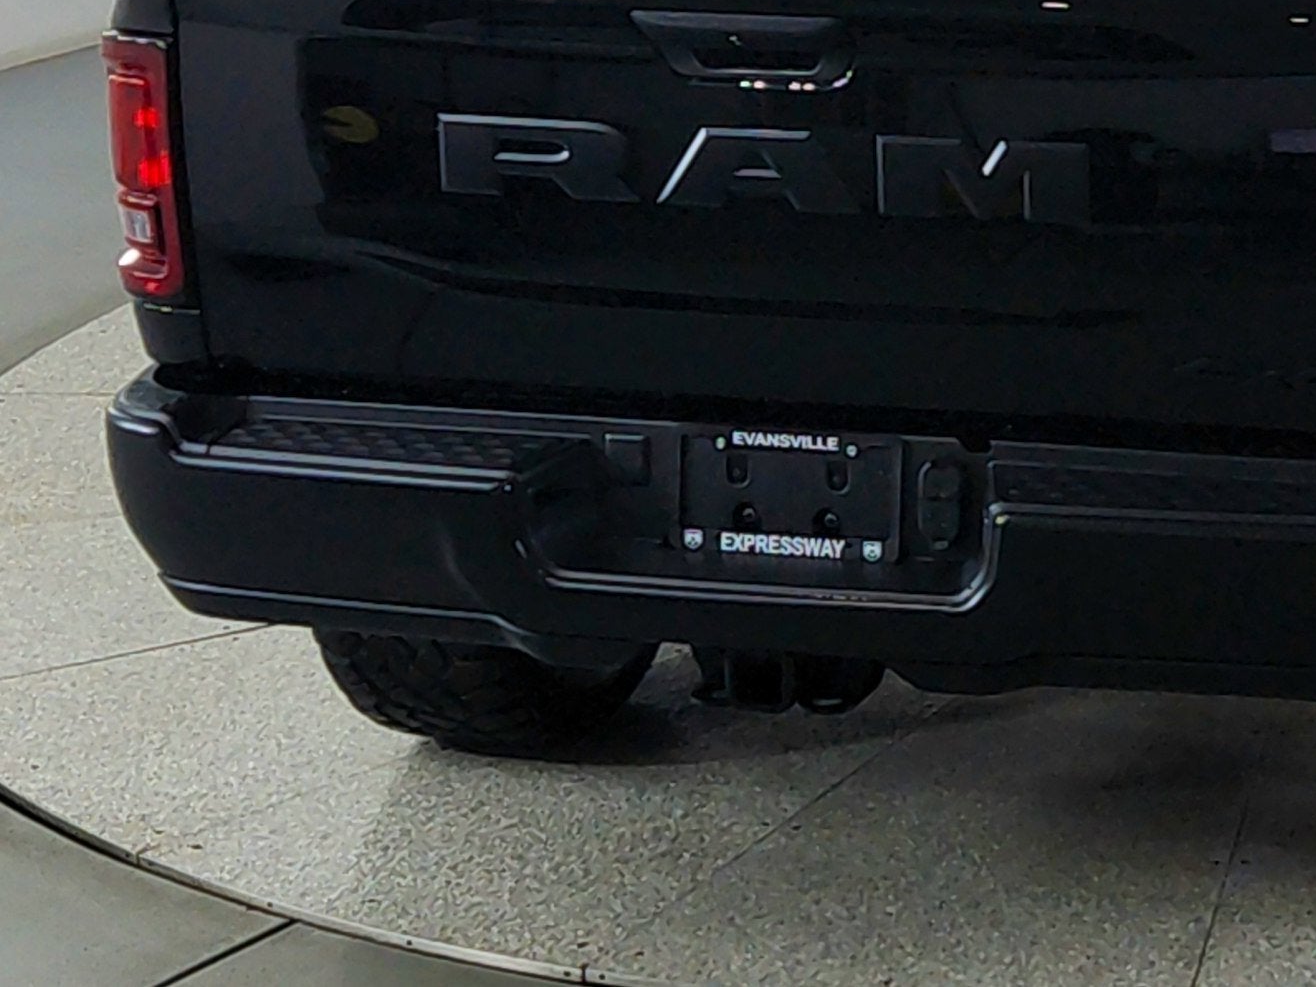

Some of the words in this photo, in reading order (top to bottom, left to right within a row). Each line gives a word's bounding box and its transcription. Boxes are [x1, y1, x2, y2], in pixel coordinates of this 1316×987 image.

[437, 112, 1091, 220] RAM
[731, 430, 840, 451] EVANSVILLE
[719, 531, 847, 559] EXPRESSWAY
